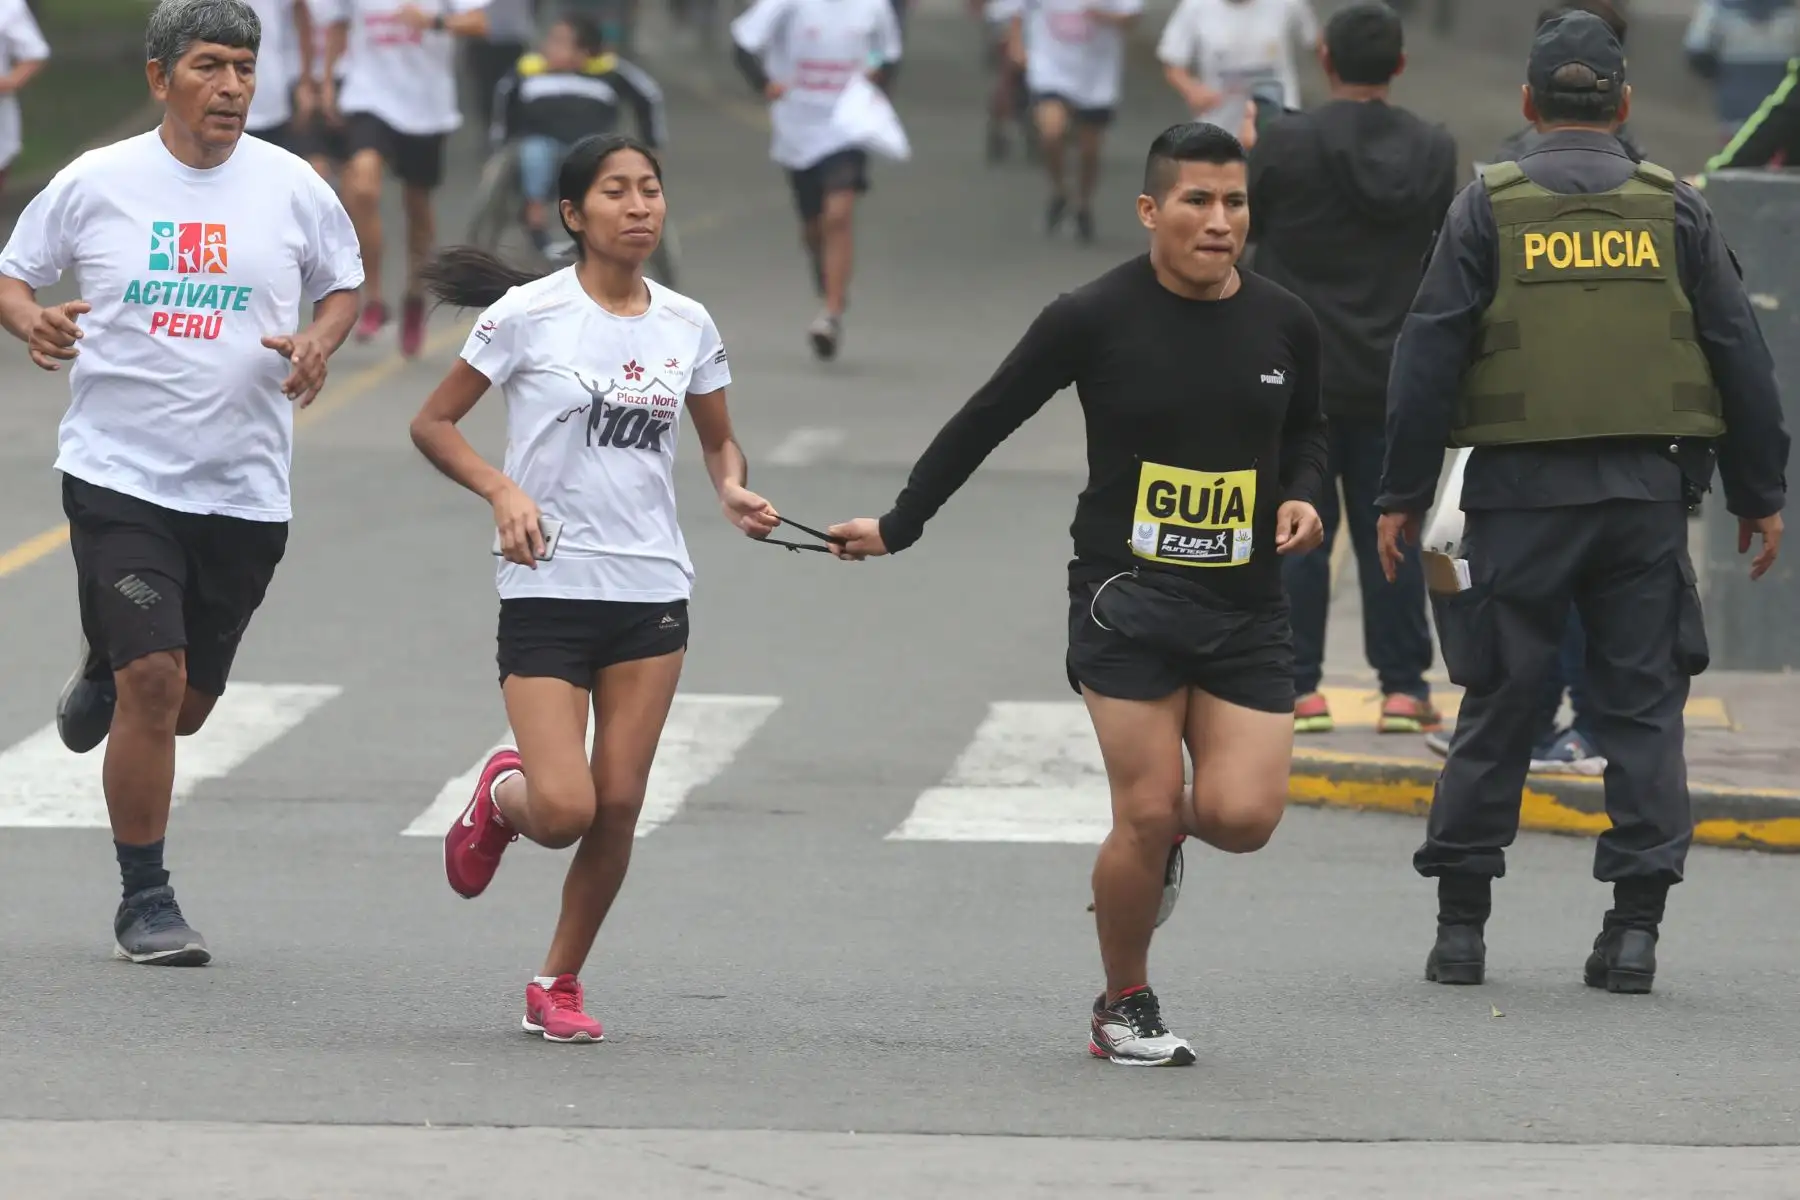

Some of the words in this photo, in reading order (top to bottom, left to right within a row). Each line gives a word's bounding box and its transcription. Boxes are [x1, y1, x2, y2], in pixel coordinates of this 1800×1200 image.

[1524, 230, 1661, 270] POLICIA
[122, 276, 253, 311] ACTÍVATE
[149, 310, 223, 340] PERÚ
[617, 392, 648, 405] Plaza
[652, 394, 679, 408] Norte
[598, 406, 671, 453] 10K
[1146, 477, 1246, 525] GUÍA
[114, 574, 162, 610] NIKE
